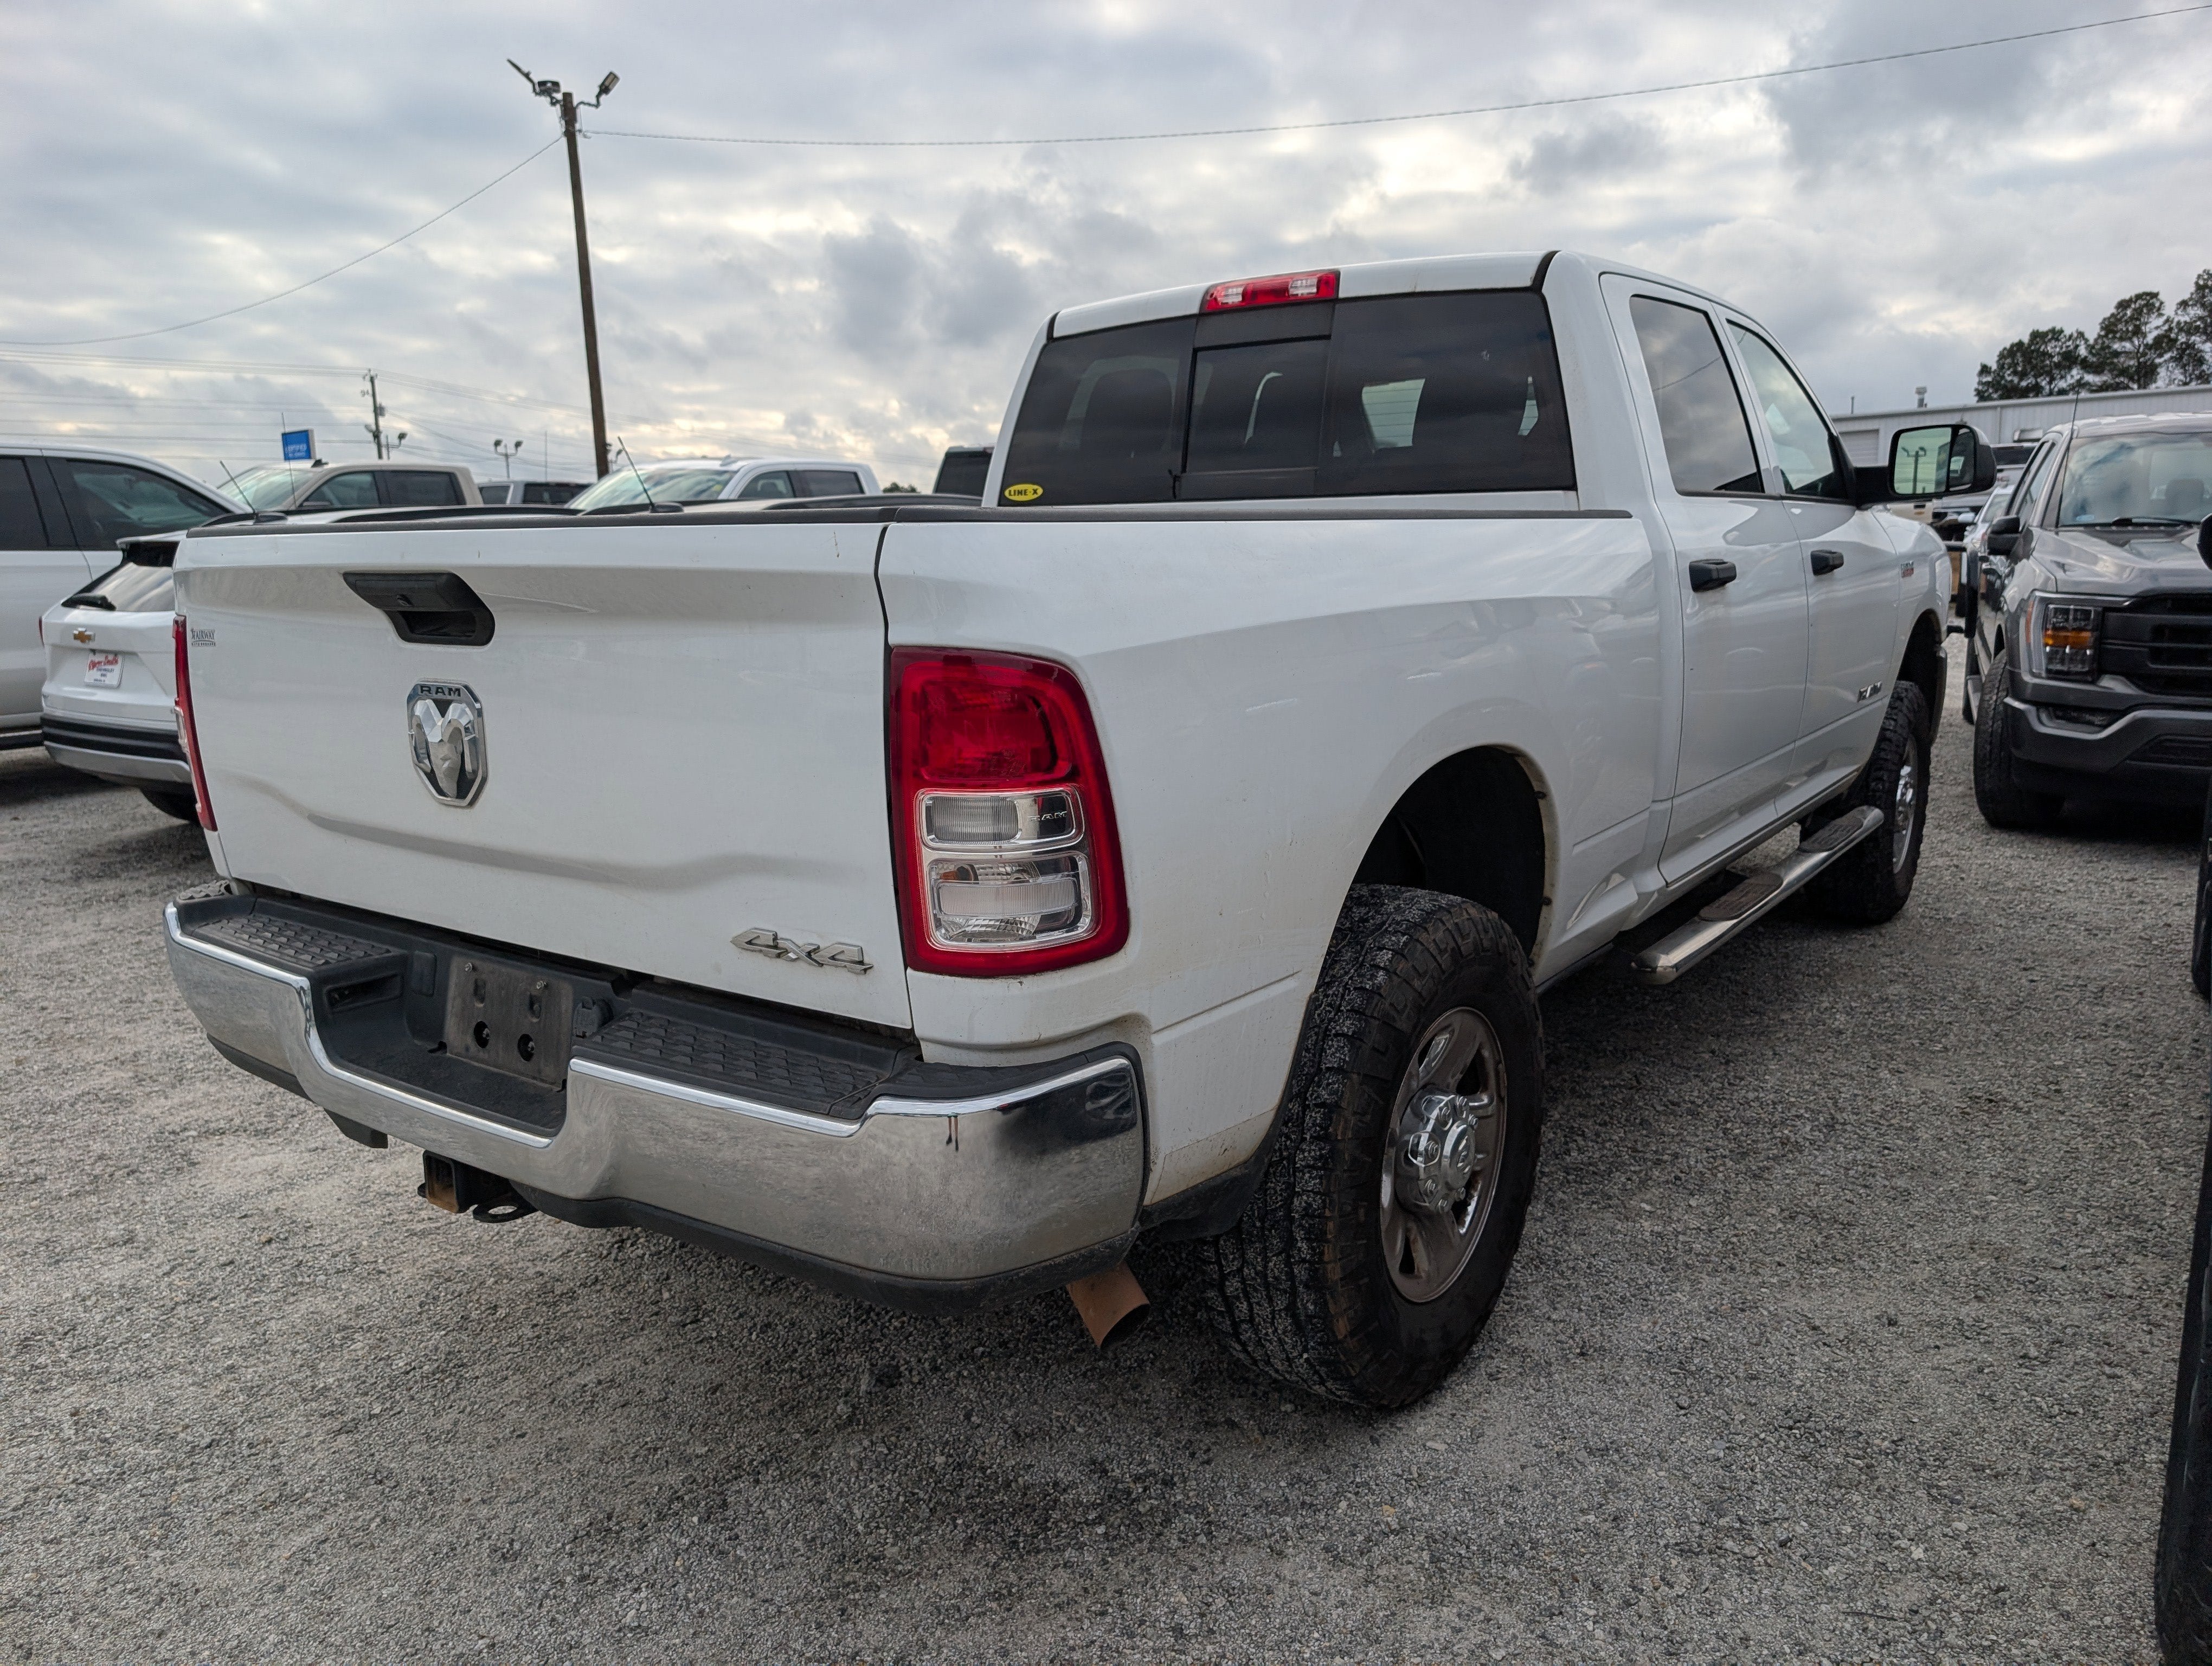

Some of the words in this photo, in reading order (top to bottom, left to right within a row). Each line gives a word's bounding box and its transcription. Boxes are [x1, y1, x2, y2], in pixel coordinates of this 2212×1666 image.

[1008, 489, 1039, 497] LINE-X
[420, 685, 461, 697] RAM
[1027, 811, 1068, 821] RAM
